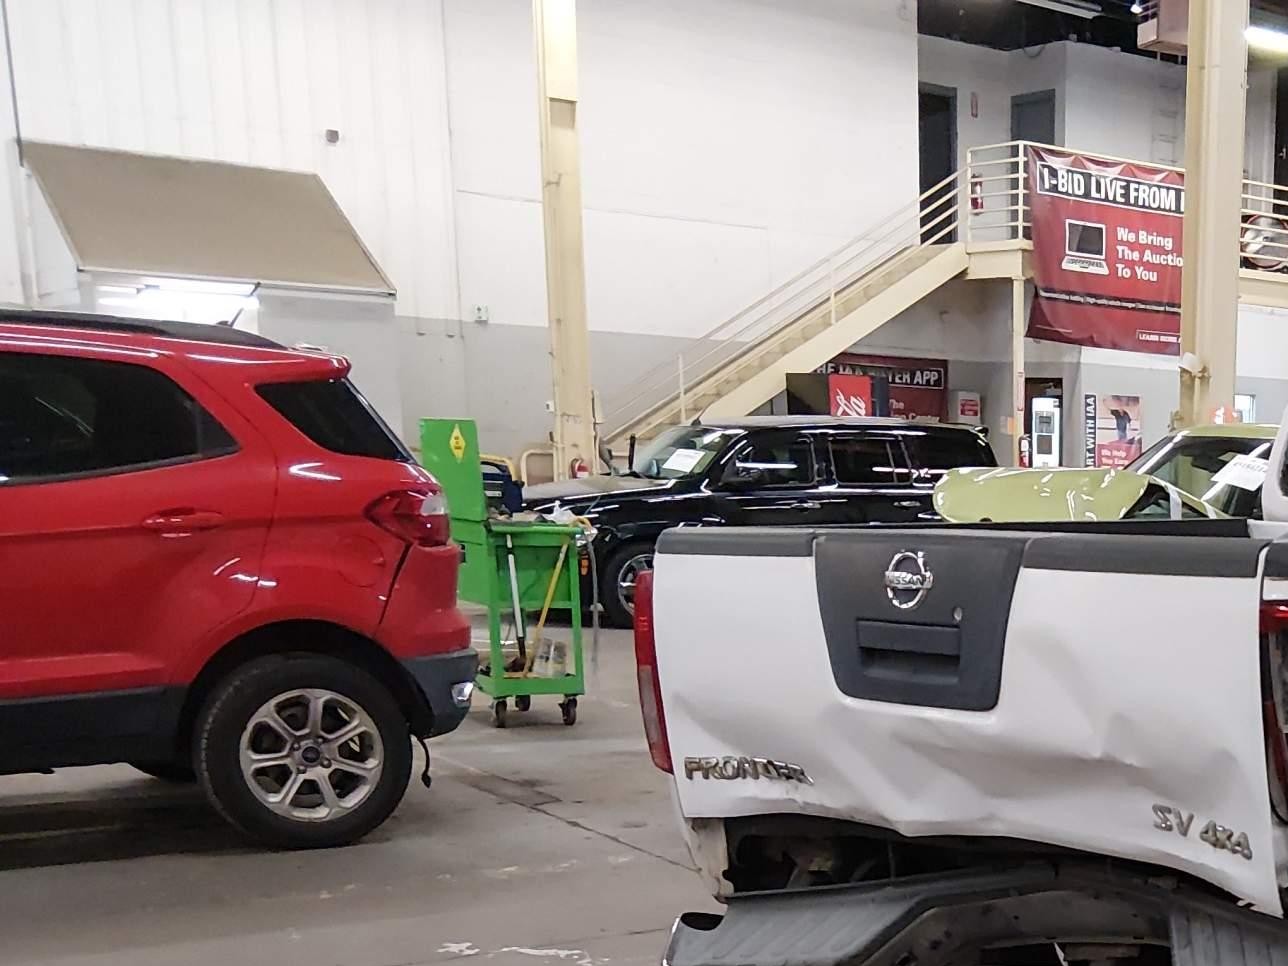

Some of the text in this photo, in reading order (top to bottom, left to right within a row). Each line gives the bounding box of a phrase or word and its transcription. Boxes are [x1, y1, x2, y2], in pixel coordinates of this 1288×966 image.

[1043, 167, 1085, 196] I-BID
[1090, 175, 1127, 203] LIVE
[1129, 181, 1176, 211] FROM
[1116, 226, 1173, 250] We Bring
[1116, 245, 1140, 261] The
[1115, 263, 1157, 281] To You
[913, 370, 939, 385] APP
[1086, 397, 1095, 417] IAA
[1086, 419, 1095, 449] WITH
[1152, 804, 1194, 838] SV
